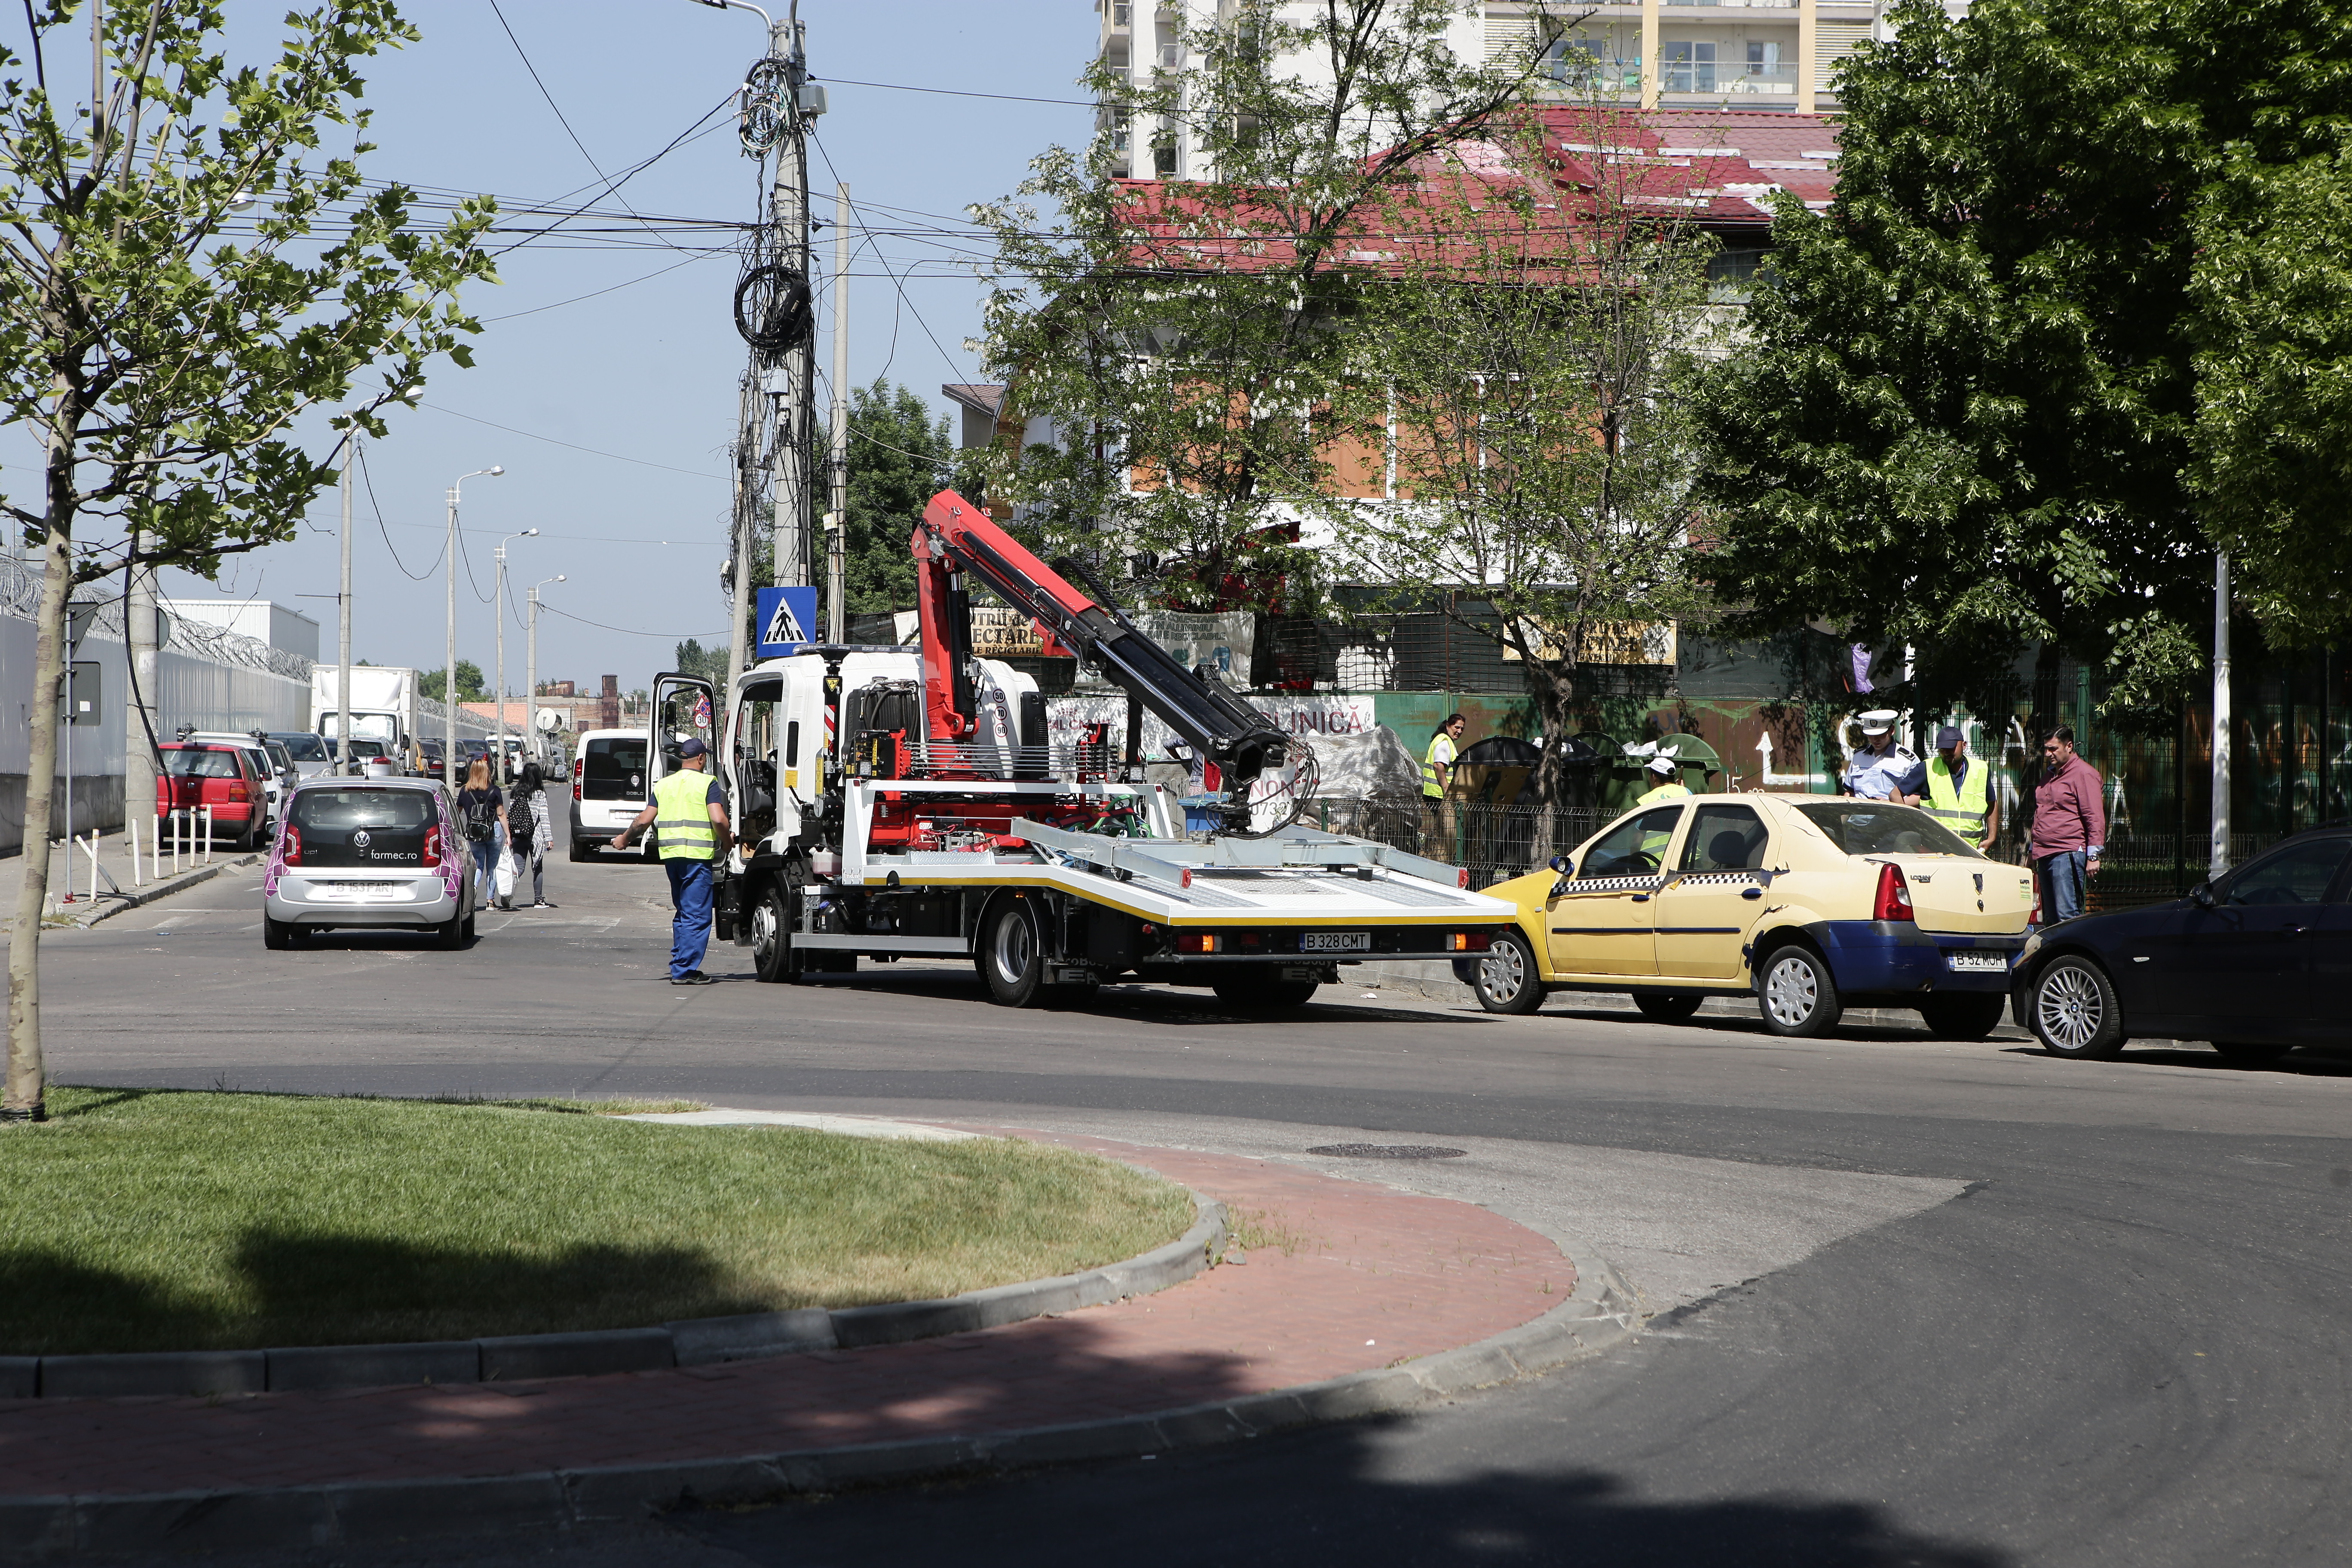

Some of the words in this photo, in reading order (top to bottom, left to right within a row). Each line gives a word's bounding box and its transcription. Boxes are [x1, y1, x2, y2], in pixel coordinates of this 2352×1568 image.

[1168, 612, 1219, 623] COLECTARE
[1148, 621, 1164, 630] DIN
[1166, 622, 1213, 632] ALUMINIU
[1171, 632, 1225, 641] RECICLABILE
[371, 849, 417, 859] farmec.ro
[337, 882, 345, 892] B
[349, 882, 365, 892] 153
[367, 882, 389, 892] FAR
[1307, 935, 1315, 948] B
[1318, 934, 1340, 948] 328
[1341, 934, 1366, 948] CMT
[1956, 952, 1964, 965] B
[1967, 952, 1981, 965] 52
[1982, 952, 2003, 966] MUH
